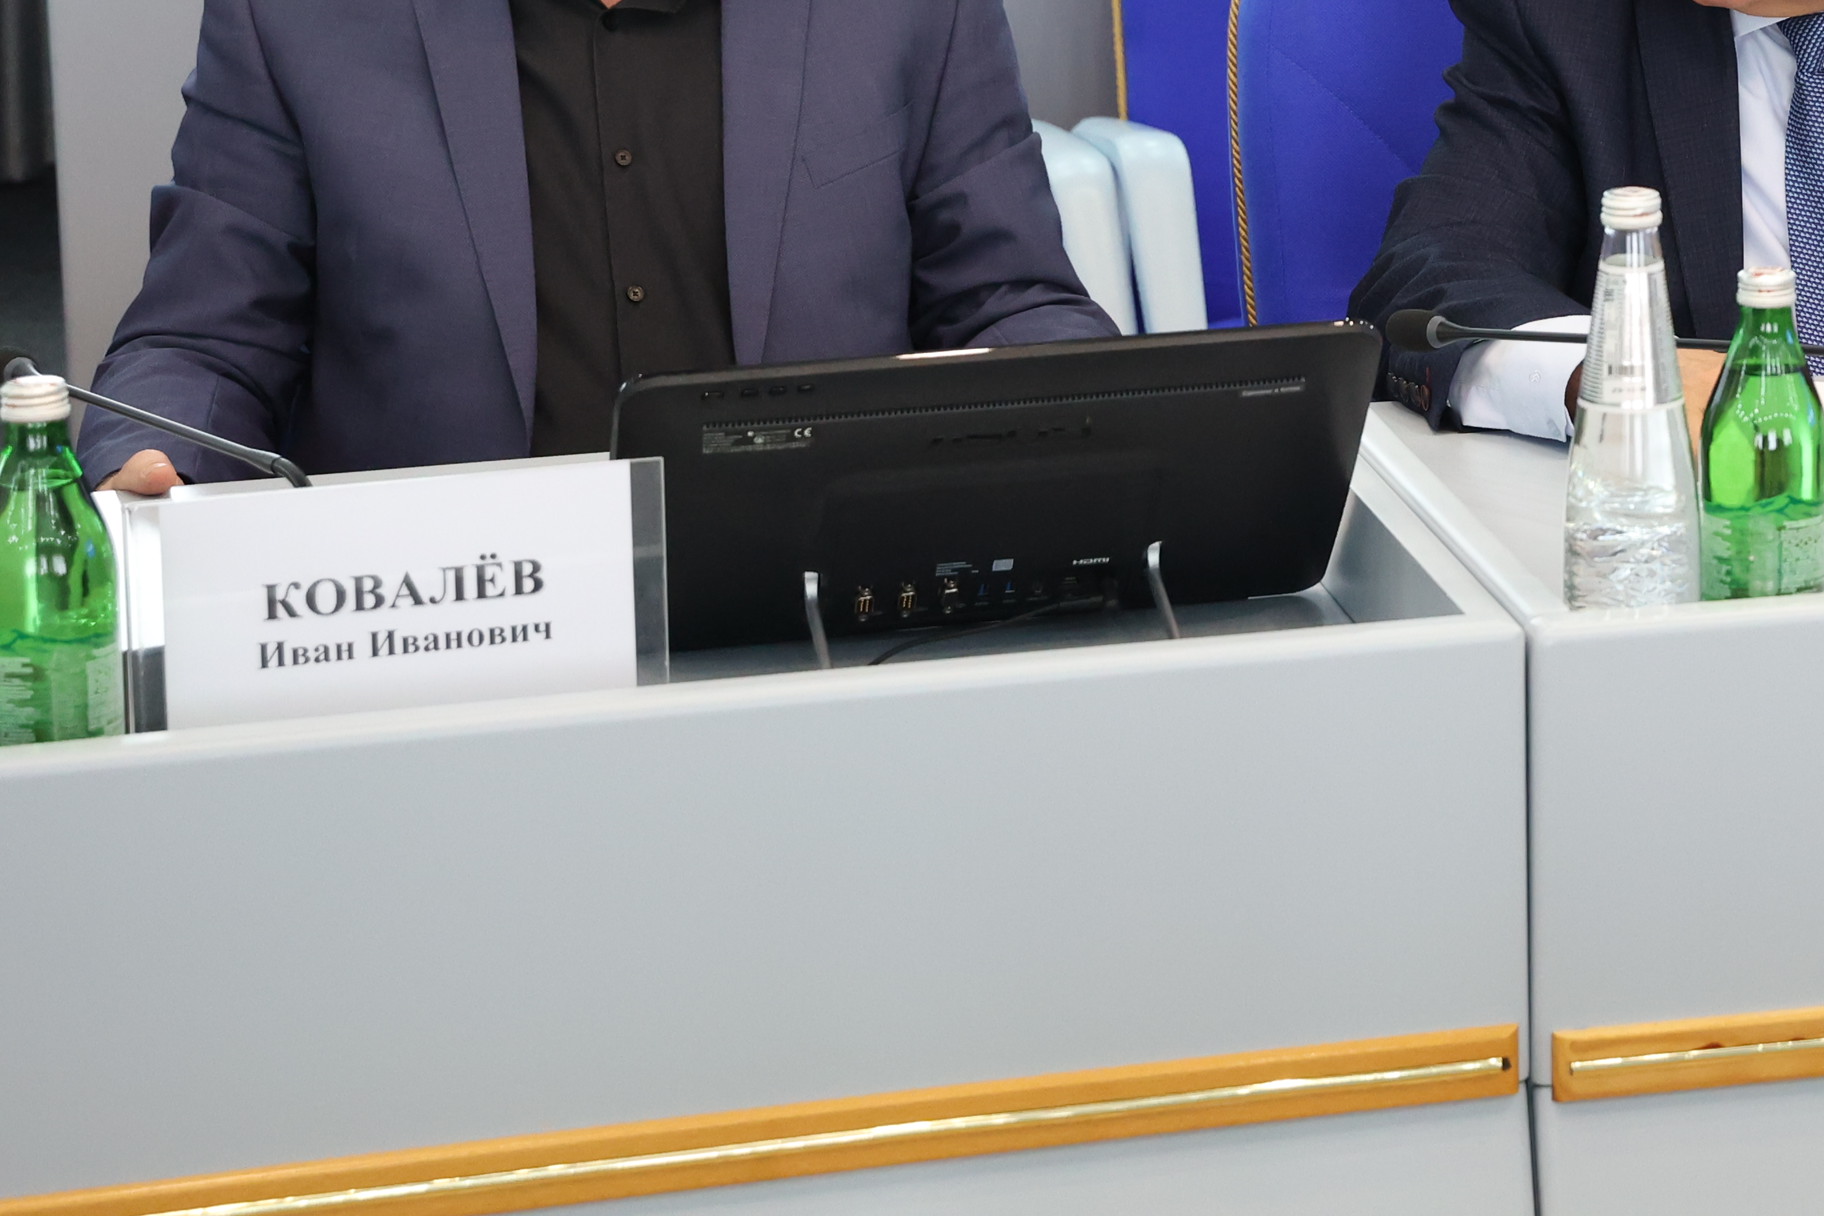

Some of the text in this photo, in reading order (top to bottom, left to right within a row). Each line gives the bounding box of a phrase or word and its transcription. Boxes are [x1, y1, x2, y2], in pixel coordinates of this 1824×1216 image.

[264, 553, 545, 621] КОВАЛЁВ
[259, 621, 553, 670] Иван Иванович
